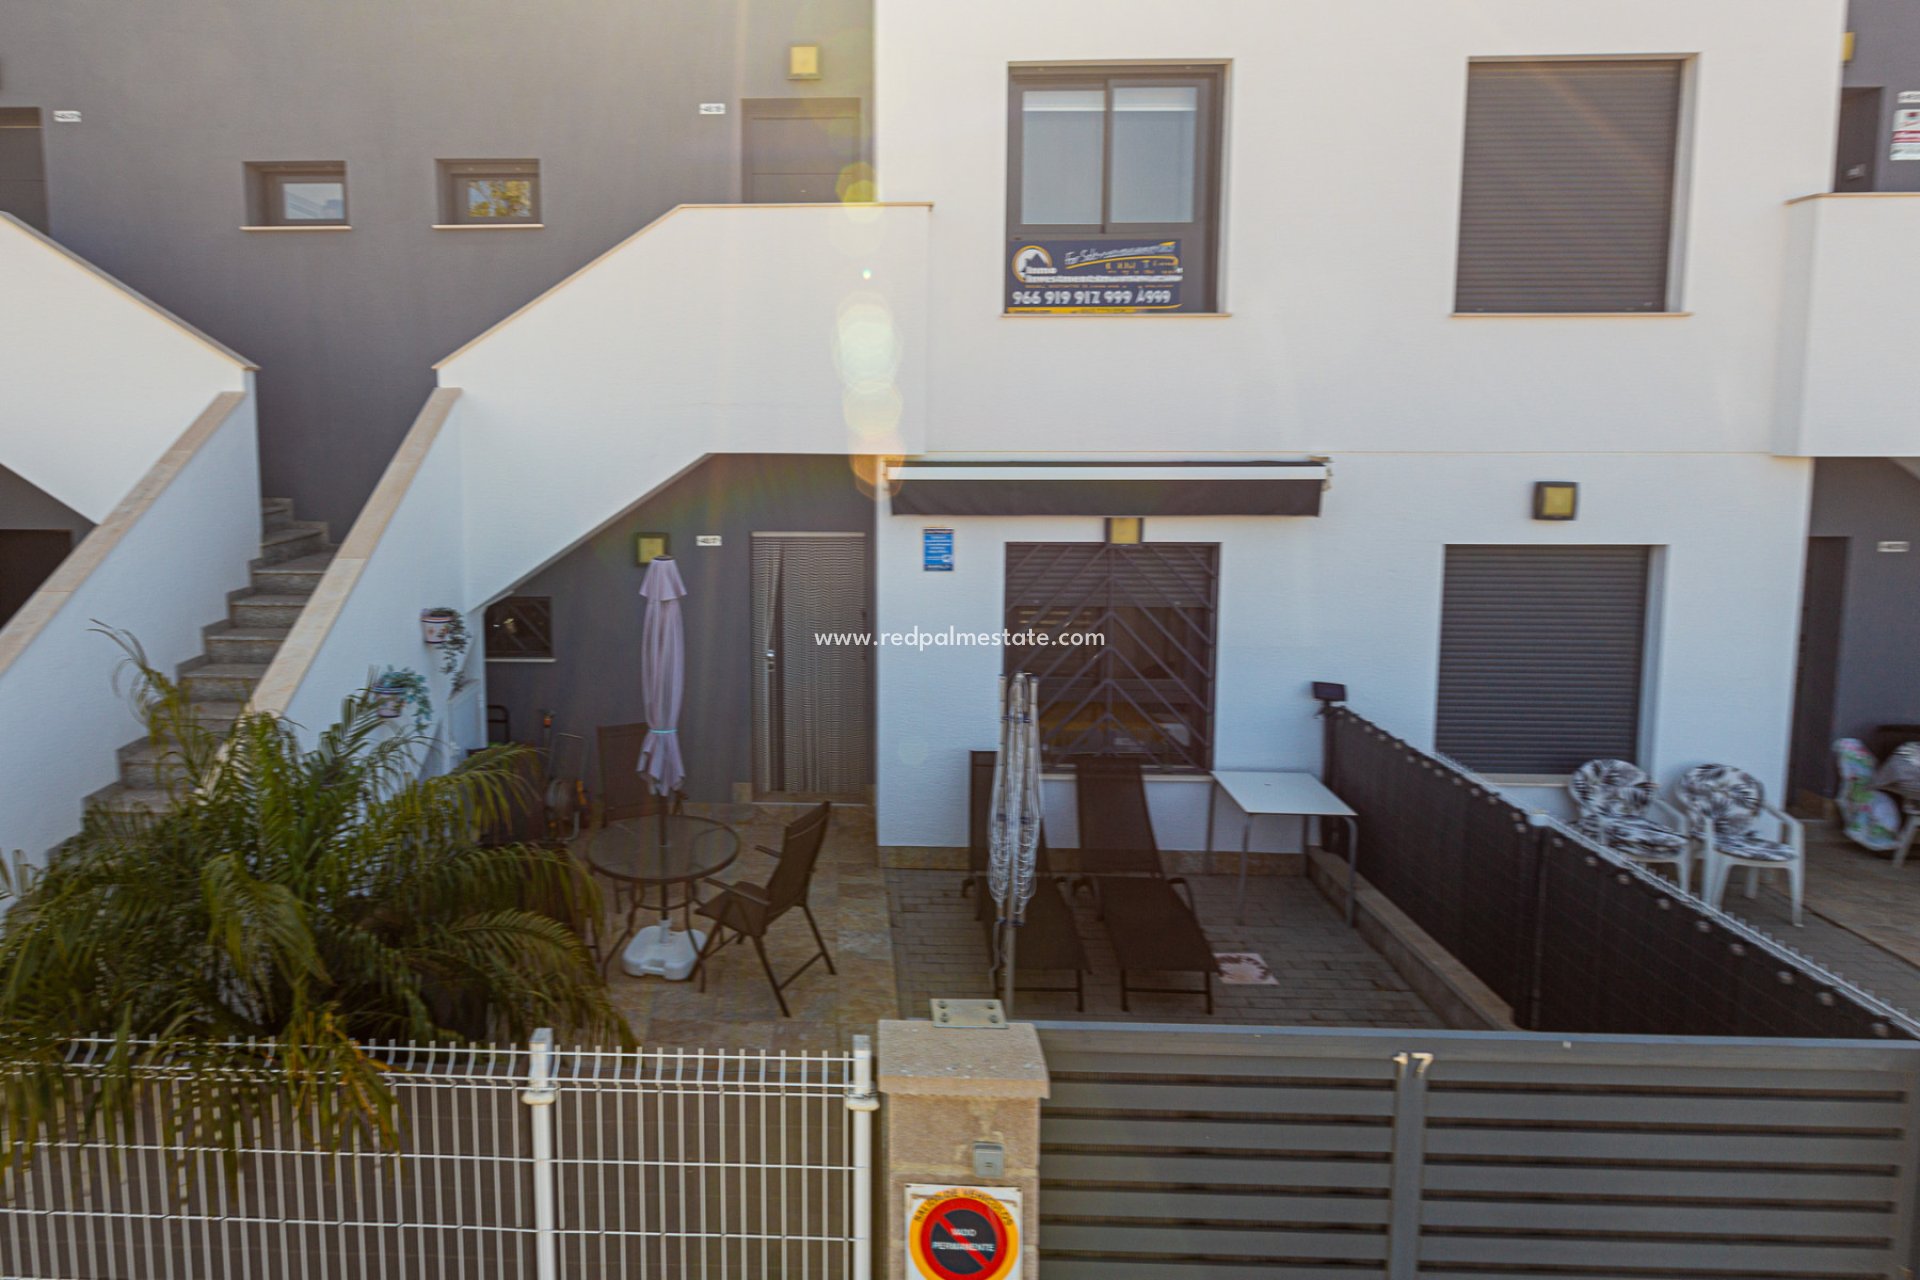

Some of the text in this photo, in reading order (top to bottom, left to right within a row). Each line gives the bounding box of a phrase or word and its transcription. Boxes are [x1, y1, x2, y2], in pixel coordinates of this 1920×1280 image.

[1012, 290, 1042, 305] 966
[1044, 290, 1072, 305] 919
[1392, 1051, 1434, 1073] 17
